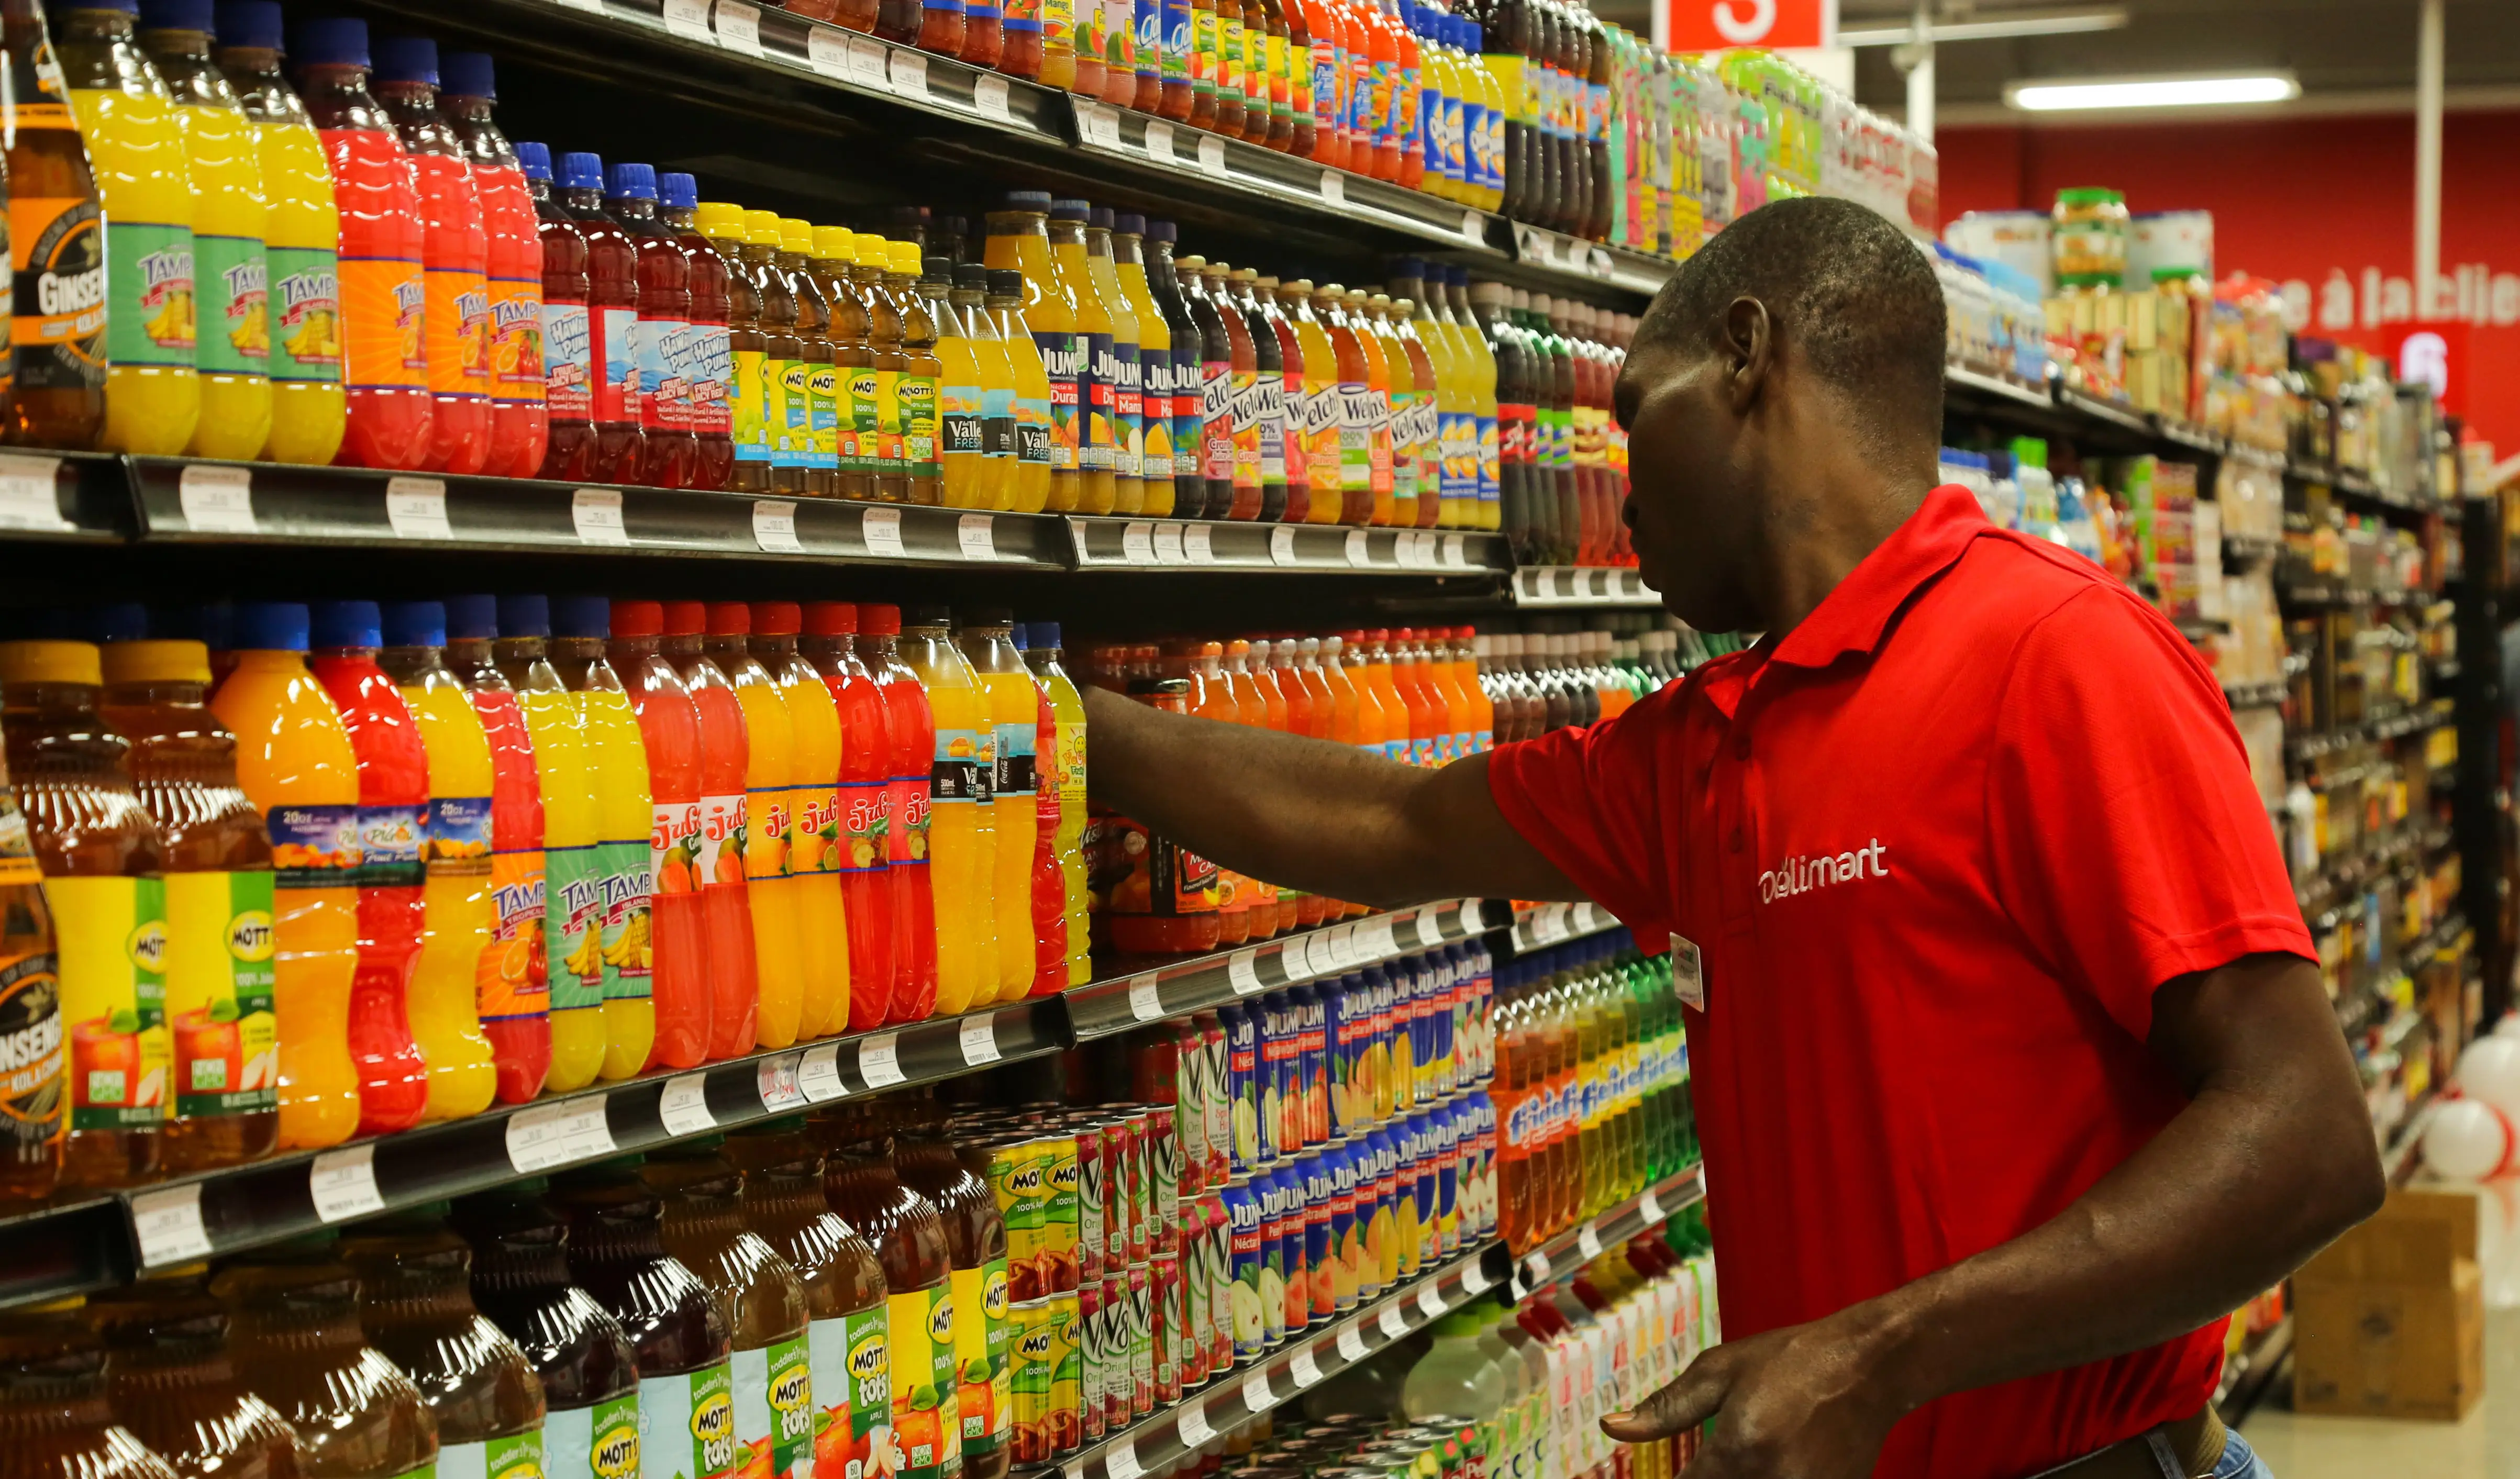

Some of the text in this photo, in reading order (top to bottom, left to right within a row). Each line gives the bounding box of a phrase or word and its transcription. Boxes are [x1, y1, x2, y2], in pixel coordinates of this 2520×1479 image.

[949, 421, 981, 438] Valle
[1103, 1293, 1128, 1349] V8
[849, 1322, 874, 1342] toddler's
[989, 1331, 1003, 1345] 100%
[771, 1350, 797, 1374] toddler's
[853, 1345, 887, 1372] MOTT'S
[934, 1355, 951, 1371] 100%
[775, 1370, 811, 1404] MOTT'S
[859, 1372, 887, 1408] tots
[781, 1404, 810, 1442] tots
[869, 1410, 882, 1422] APPLE
[965, 1416, 983, 1428] NON
[965, 1426, 984, 1437] GMO
[598, 1433, 638, 1467] MOTT'S
[703, 1433, 731, 1472] tots
[793, 1442, 805, 1455] APPLE
[913, 1445, 931, 1456] NON
[913, 1454, 932, 1466] GMO
[850, 1464, 858, 1476] 60
